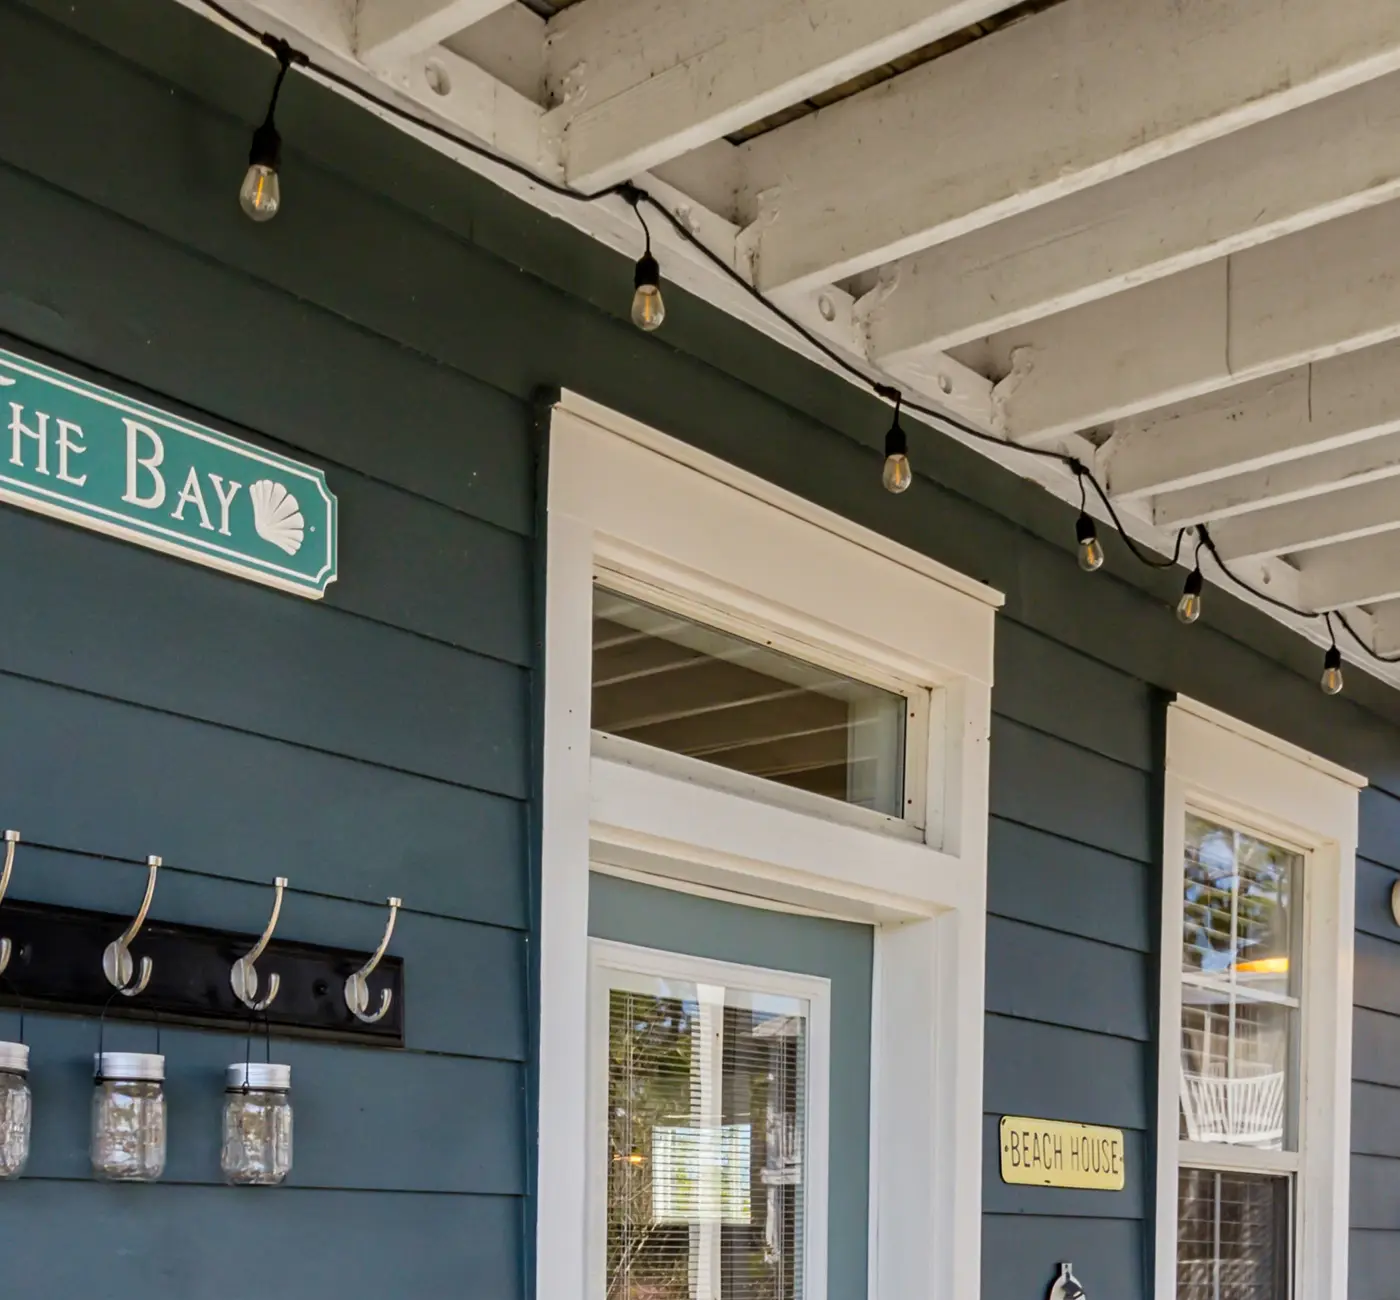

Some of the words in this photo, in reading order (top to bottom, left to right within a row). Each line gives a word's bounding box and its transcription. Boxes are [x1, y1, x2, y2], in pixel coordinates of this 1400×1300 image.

[0, 376, 87, 487] HE
[121, 417, 242, 536] BAY
[1010, 1130, 1063, 1170] BEACH
[1070, 1134, 1119, 1174] HOUSE
